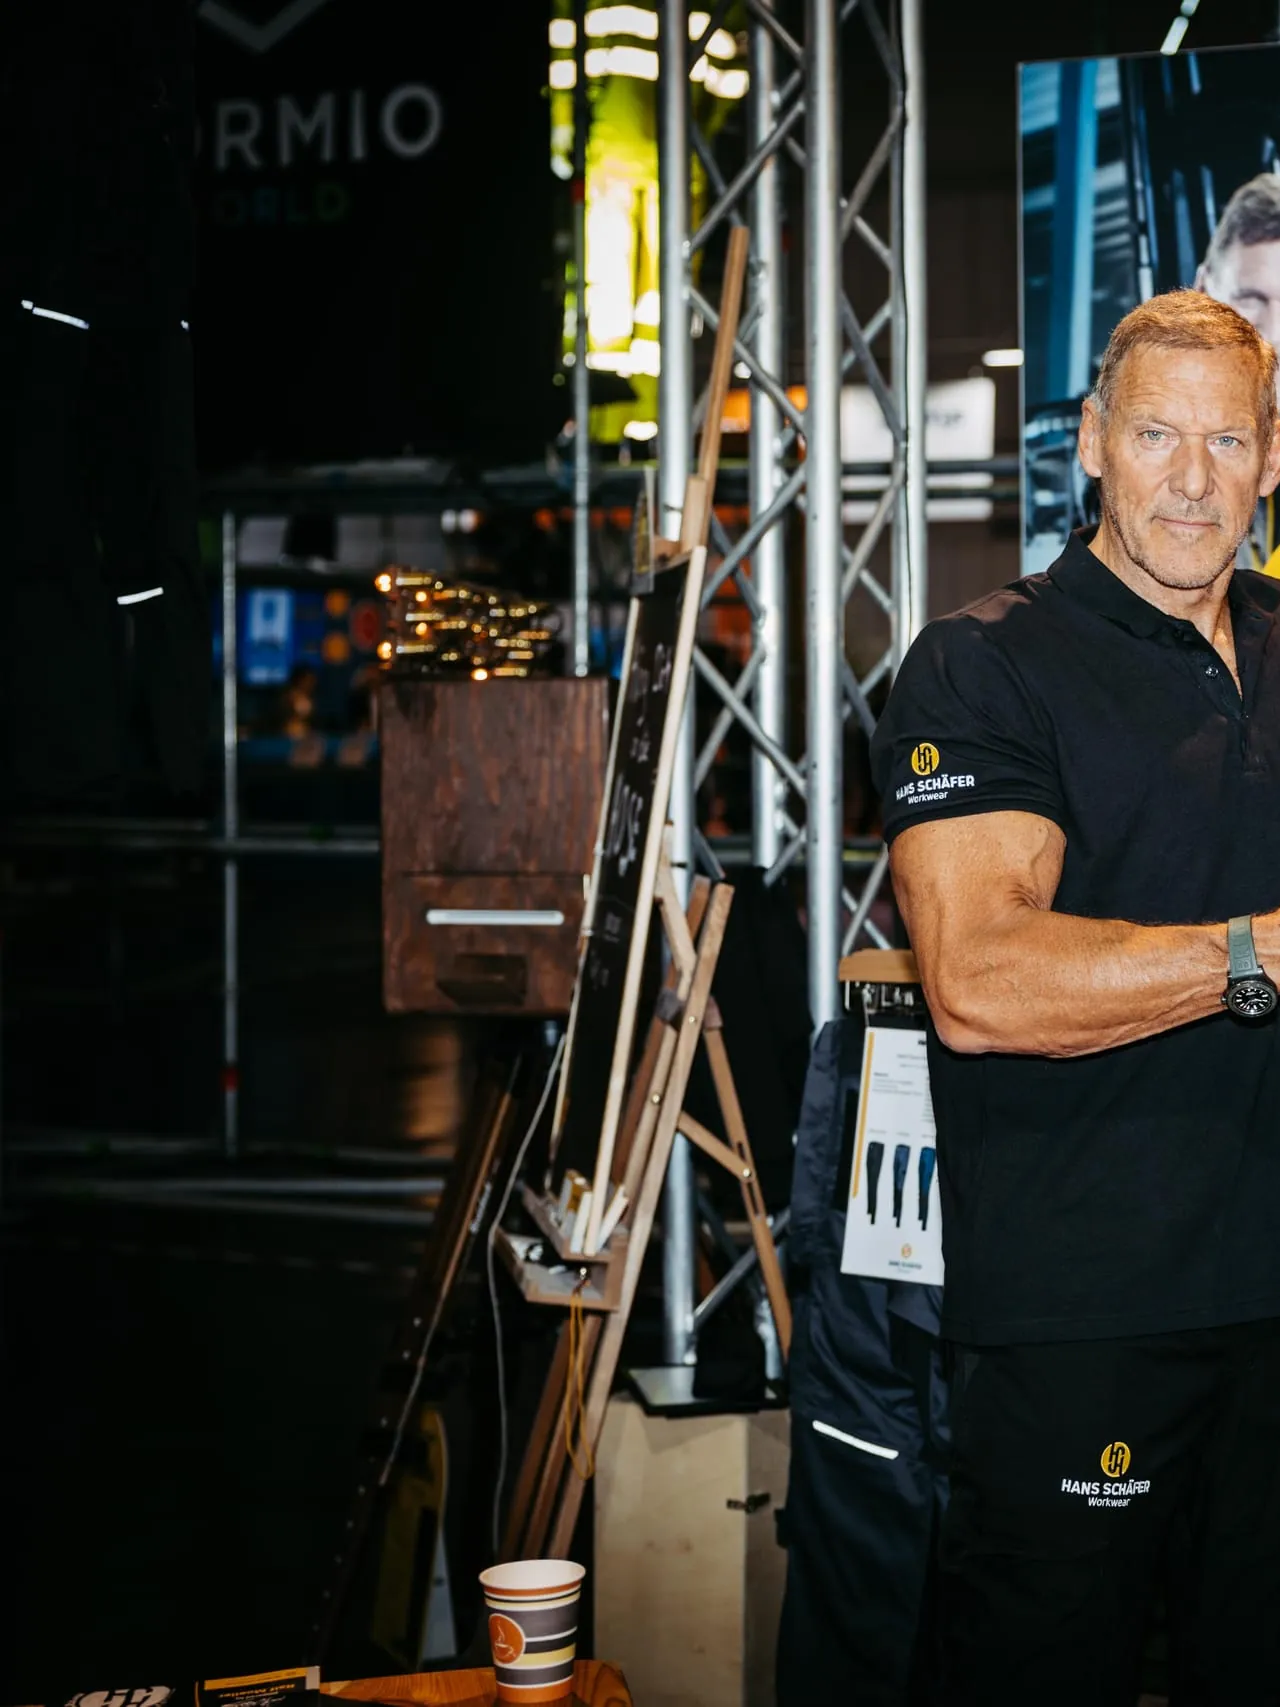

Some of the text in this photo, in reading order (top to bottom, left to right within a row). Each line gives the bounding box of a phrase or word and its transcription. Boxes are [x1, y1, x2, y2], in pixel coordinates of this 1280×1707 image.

[193, 79, 445, 173] RMIO
[896, 774, 975, 800] HANS SCHÄFER
[908, 792, 949, 804] Workwear
[1061, 1478, 1151, 1496] HANS SCHÄFER
[1088, 1496, 1132, 1508] Workwear
